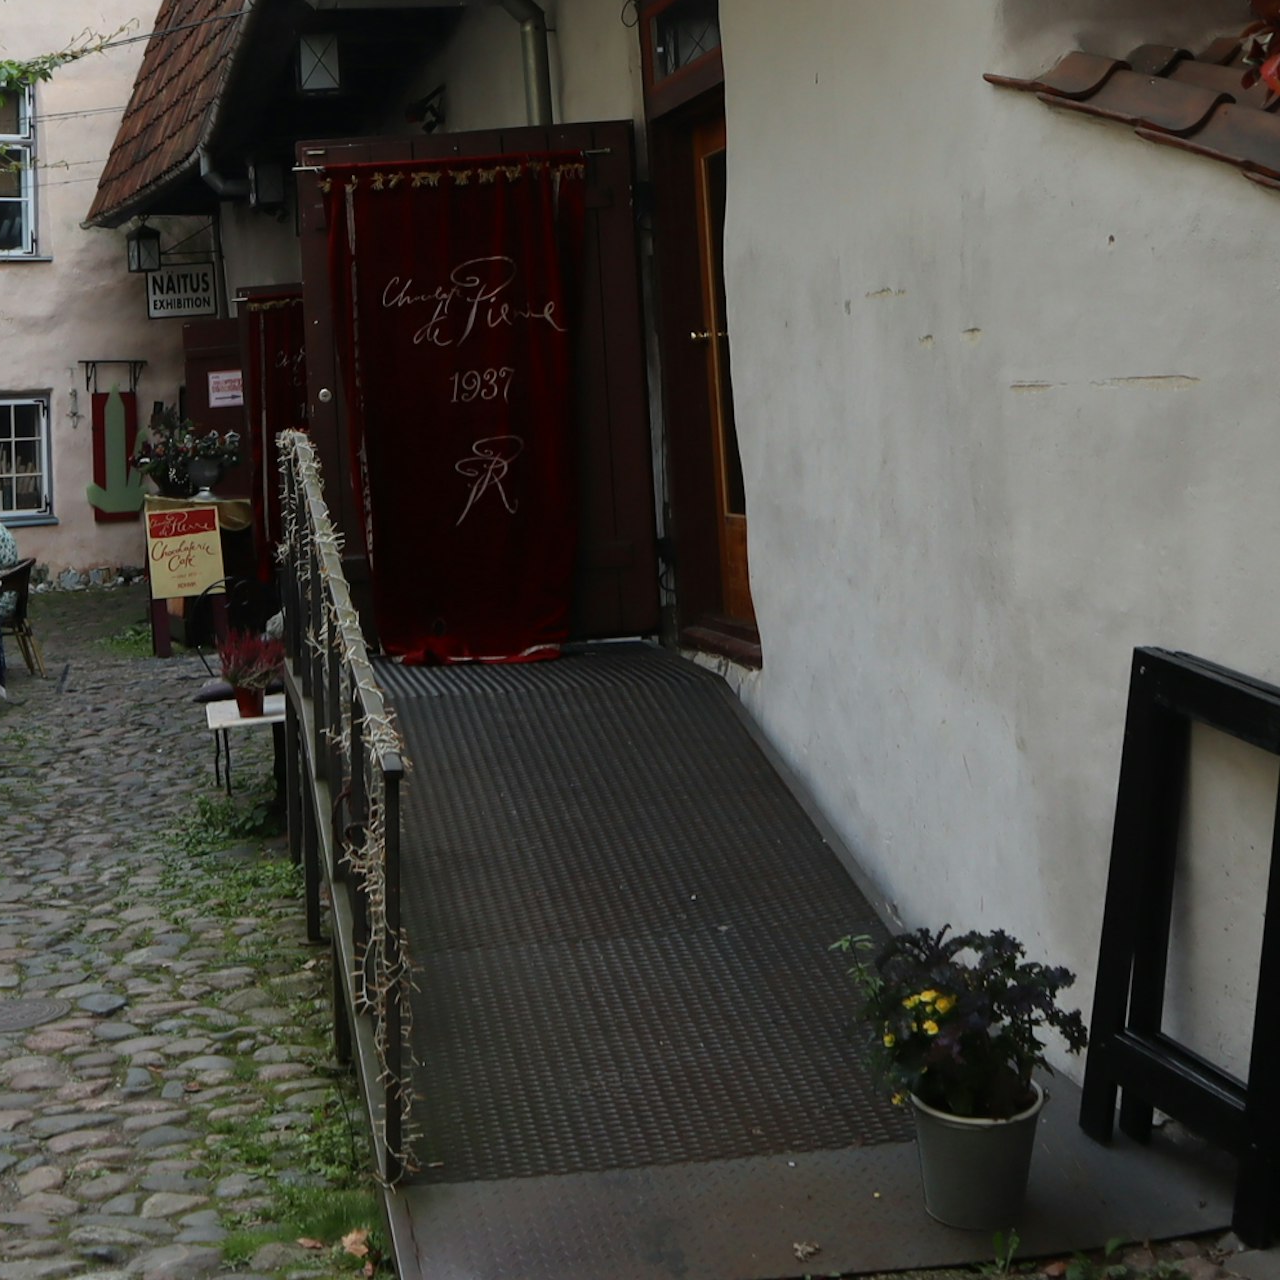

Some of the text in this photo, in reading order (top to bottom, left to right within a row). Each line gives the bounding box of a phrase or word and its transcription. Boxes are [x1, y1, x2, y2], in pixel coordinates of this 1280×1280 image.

[152, 270, 210, 296] NÄITUS
[153, 296, 211, 311] EXHIBITION
[450, 255, 568, 348] Pierre
[450, 366, 515, 405] 1937
